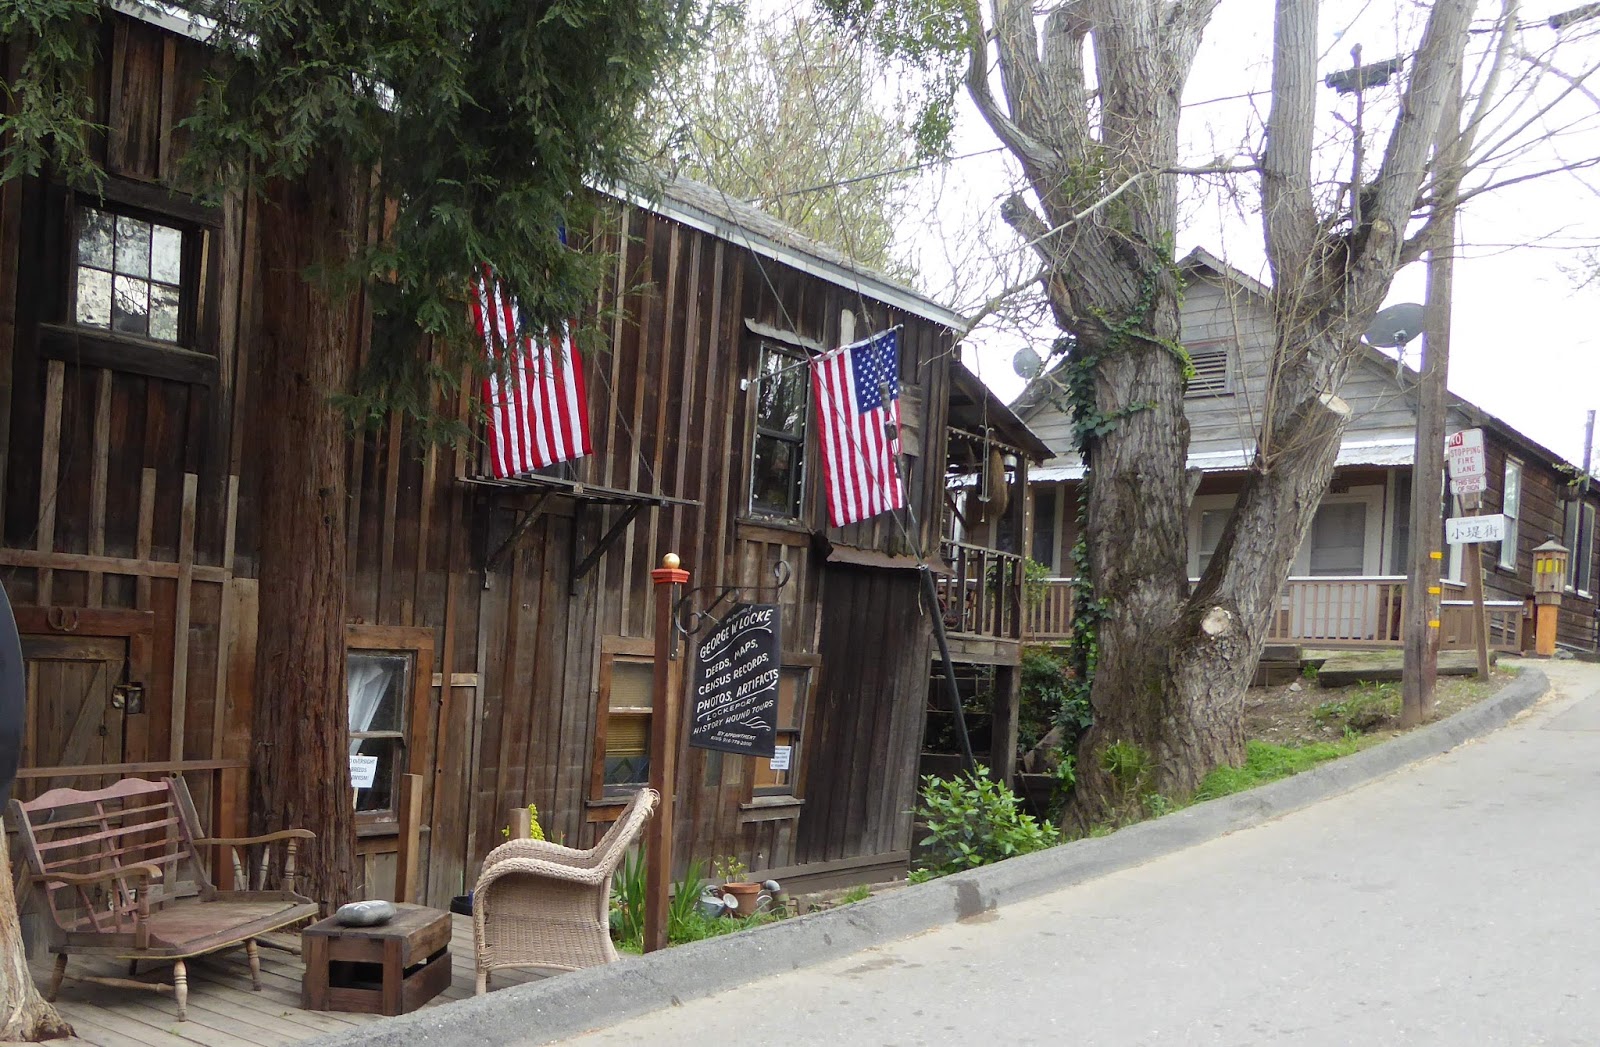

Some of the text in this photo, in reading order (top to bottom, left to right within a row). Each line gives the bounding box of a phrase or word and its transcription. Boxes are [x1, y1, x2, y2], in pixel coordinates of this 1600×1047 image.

[1449, 433, 1462, 446] NO
[1450, 446, 1481, 458] STOPPING
[1457, 456, 1475, 465] FIRE
[1457, 465, 1476, 473] LANE
[1451, 524, 1500, 540] 小堤街
[700, 627, 729, 659] GEORGE
[739, 609, 773, 630] LOCKE
[705, 639, 759, 678] DEEDS, MAPS,
[698, 652, 769, 695] CENSUS RECORDS,
[697, 669, 779, 713] PHOTOS, ARTIFACTS
[693, 700, 774, 735] HISTORY HOUND TOURS
[706, 696, 757, 721] LOCKEPORT
[724, 732, 757, 741] APPOINTMENT
